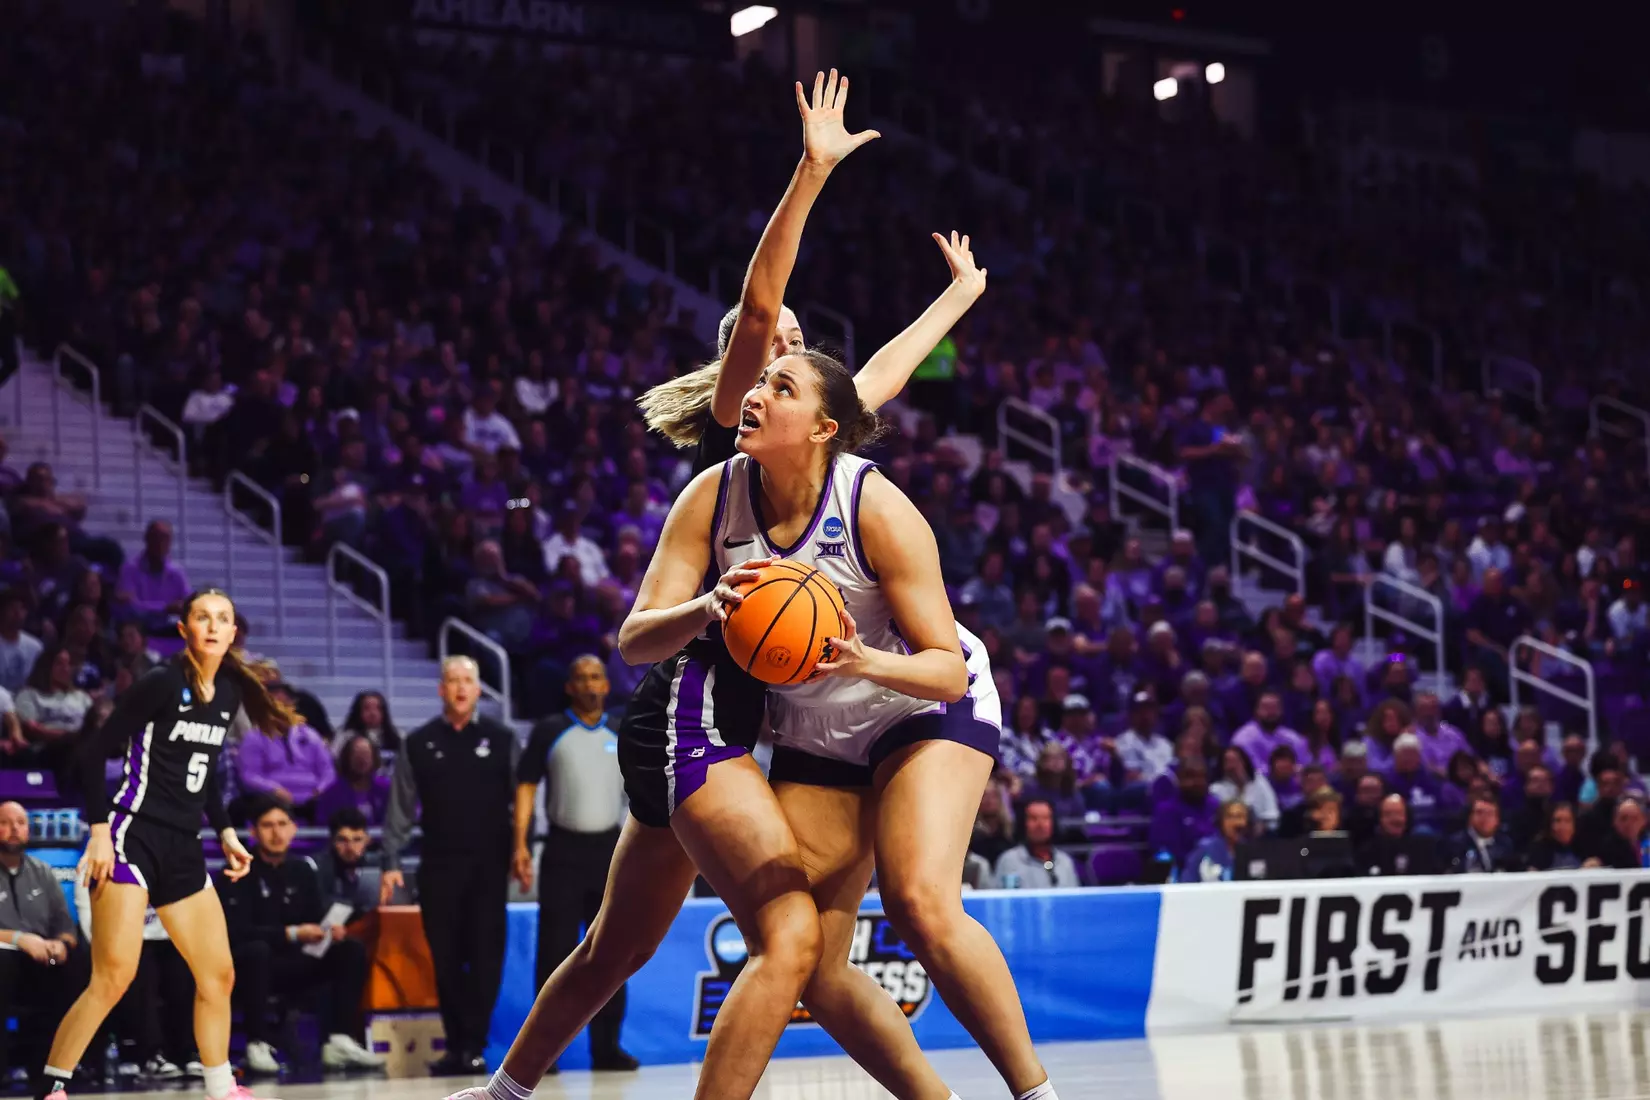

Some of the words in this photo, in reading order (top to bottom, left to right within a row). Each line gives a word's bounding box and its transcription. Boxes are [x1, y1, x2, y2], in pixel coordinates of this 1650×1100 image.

[185, 751, 209, 793] 5
[1236, 890, 1462, 1004] FIRST
[1458, 917, 1522, 960] AND
